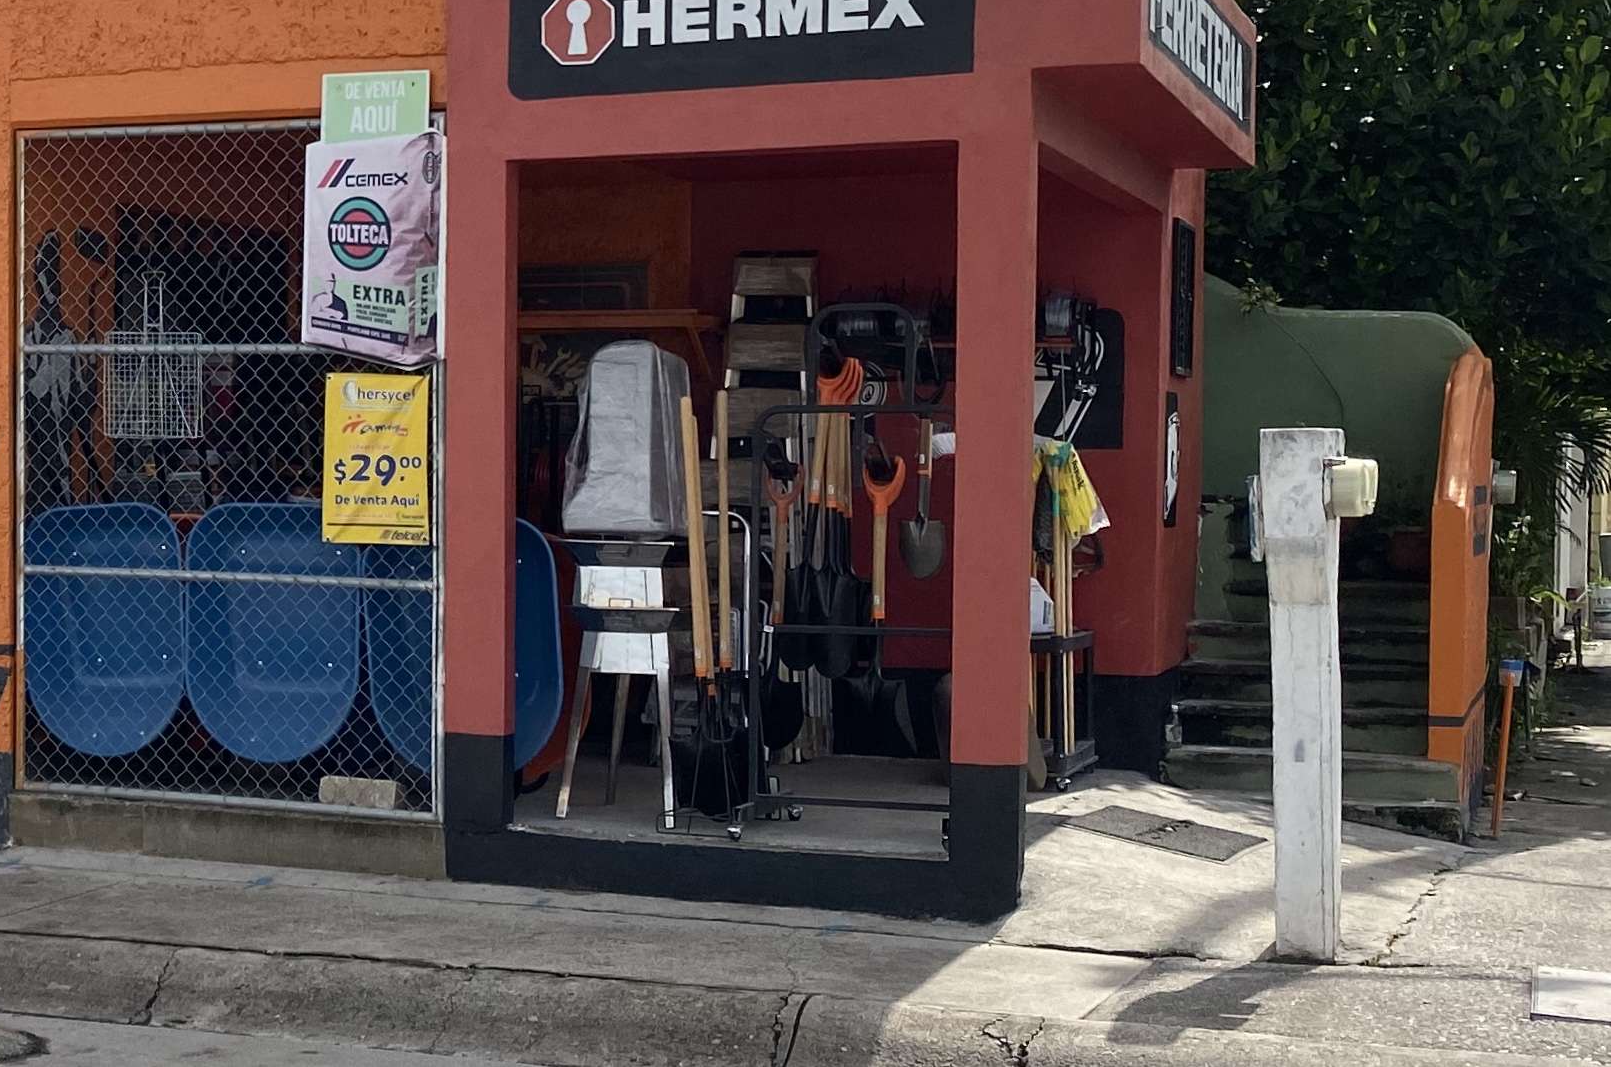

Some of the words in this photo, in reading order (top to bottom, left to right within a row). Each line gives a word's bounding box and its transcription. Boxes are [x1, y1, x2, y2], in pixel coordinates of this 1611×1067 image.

[345, 82, 360, 100] DE
[365, 80, 405, 99] VENTA
[350, 100, 398, 133] AQUÍ
[345, 172, 408, 188] CEMEX
[329, 223, 389, 245] TOLTECA
[353, 284, 406, 307] EXTRA
[420, 273, 429, 326] EXTRA
[335, 495, 350, 505] De
[353, 495, 387, 506] Venta
[391, 493, 420, 508] Aquí
[391, 529, 424, 541] telcel
